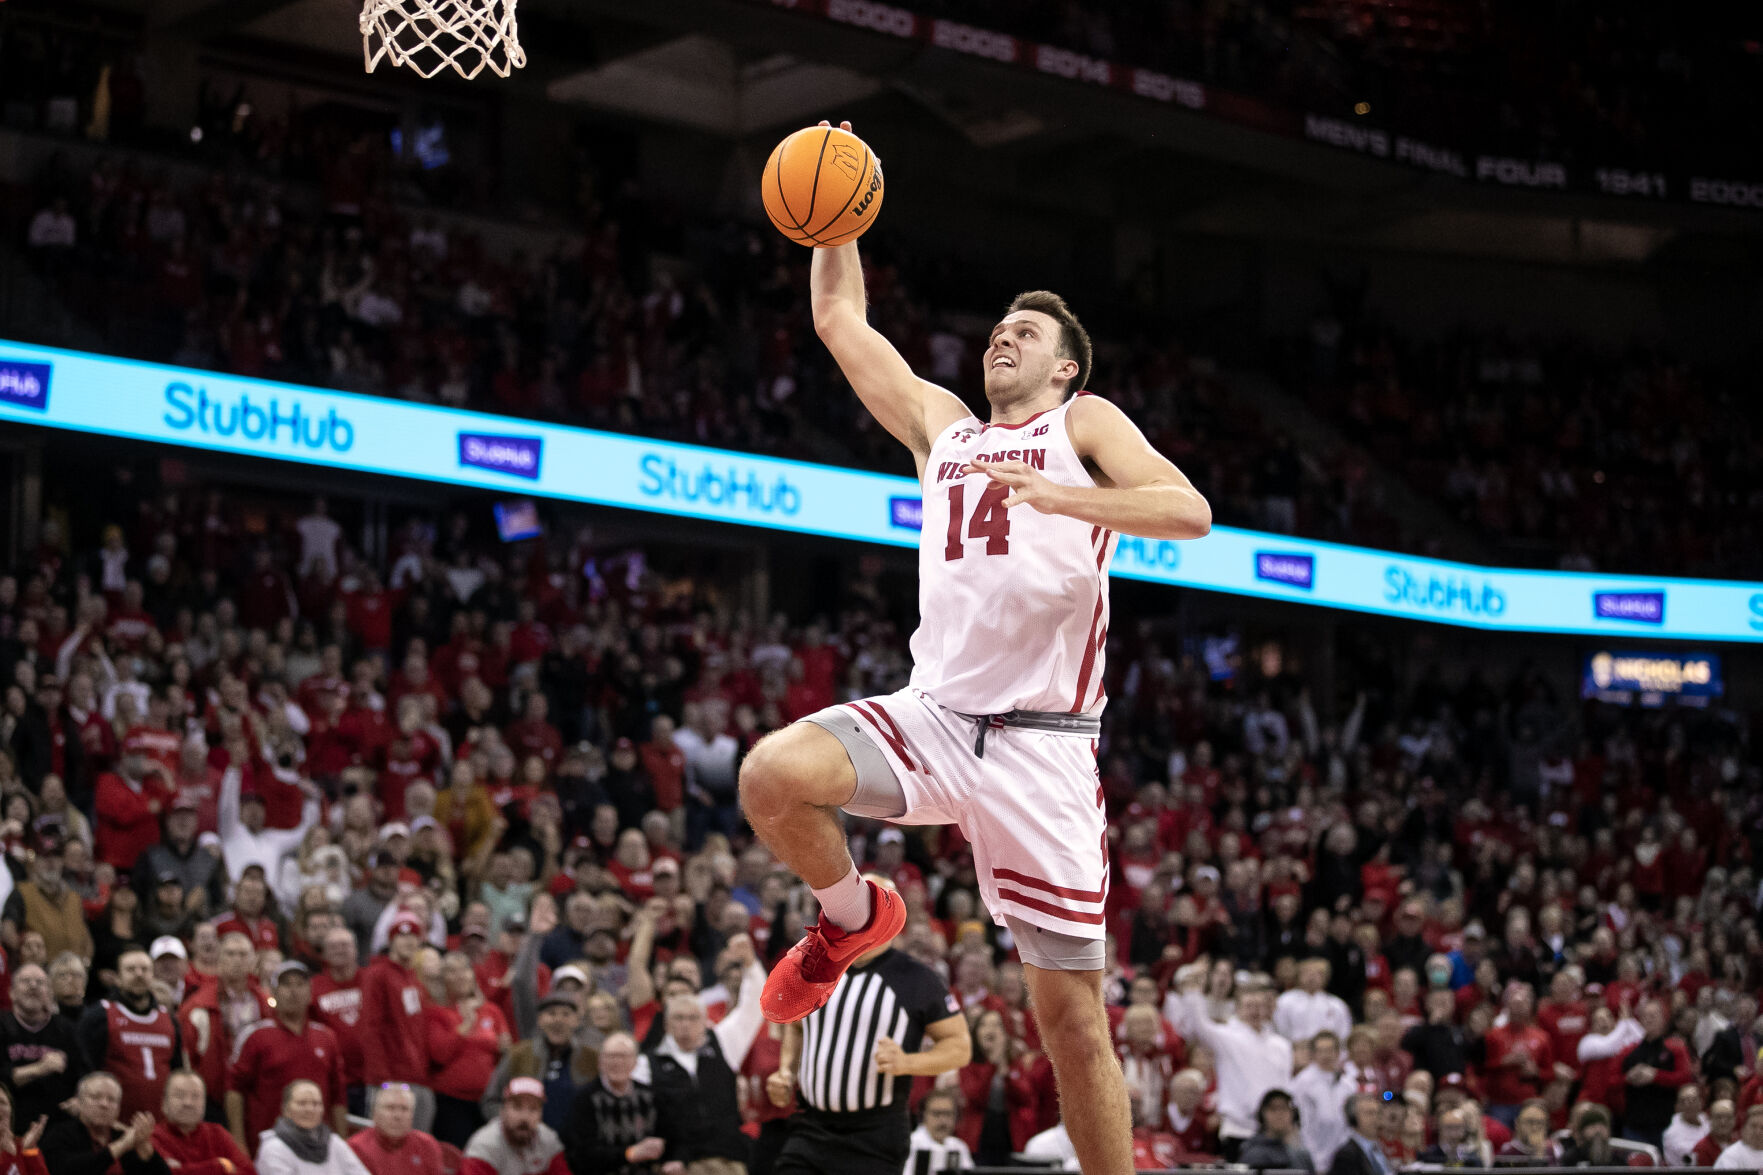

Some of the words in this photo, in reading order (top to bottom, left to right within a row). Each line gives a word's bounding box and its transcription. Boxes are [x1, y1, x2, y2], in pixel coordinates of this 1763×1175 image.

[1475, 155, 1567, 190] FOUR
[1595, 167, 1667, 197] 1941
[936, 448, 1047, 484] WISONSIN
[163, 381, 354, 451] StubHub
[638, 453, 801, 516] StubHub
[1384, 566, 1506, 618] StubHub
[945, 483, 1011, 561] 14
[141, 1046, 156, 1080] 1
